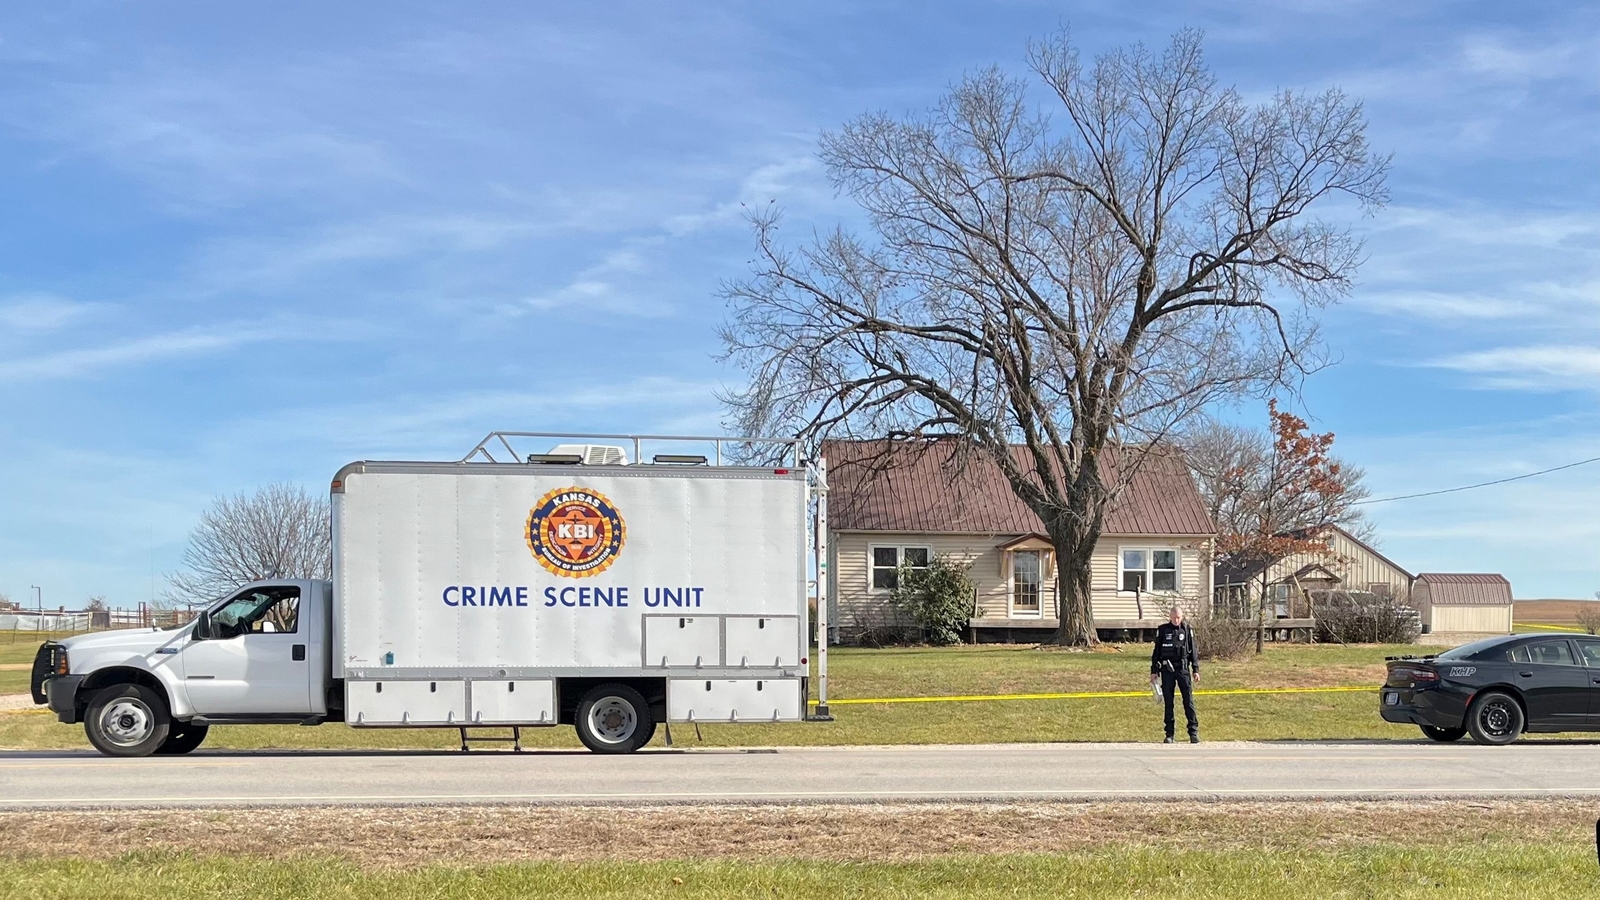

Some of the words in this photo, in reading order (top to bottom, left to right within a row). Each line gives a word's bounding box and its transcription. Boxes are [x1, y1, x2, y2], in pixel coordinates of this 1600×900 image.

[552, 493, 601, 508] KANSAS
[558, 524, 594, 539] KBI
[541, 547, 562, 566] BUREAU
[562, 561, 571, 570] OF
[572, 548, 611, 571] INVESTIGATION
[442, 586, 528, 607] CRIME
[544, 586, 629, 608] SCENE
[644, 587, 704, 608] UNIT
[1449, 666, 1477, 677] KHP
